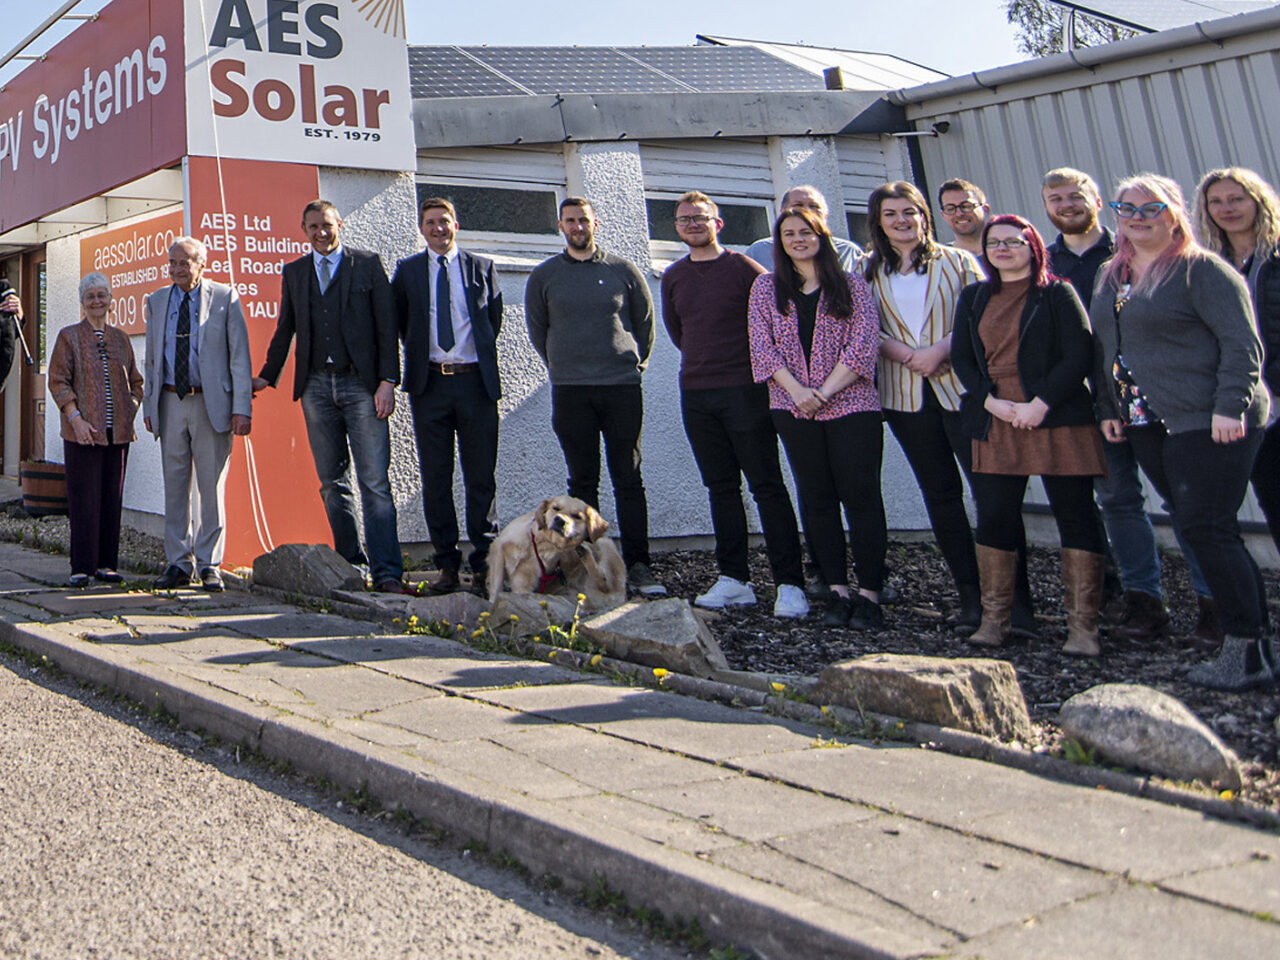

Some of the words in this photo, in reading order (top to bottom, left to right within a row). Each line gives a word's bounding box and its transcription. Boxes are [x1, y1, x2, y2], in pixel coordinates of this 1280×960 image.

[33, 35, 167, 164] Systems
[210, 58, 391, 129] Solar
[304, 127, 339, 140] EST.
[344, 130, 381, 142] 1979
[200, 212, 237, 230] AES
[243, 214, 271, 231] Ltd
[94, 227, 183, 270] aessolar.co
[202, 234, 237, 252] AES
[245, 236, 312, 257] Building
[240, 257, 284, 274] Road
[111, 266, 158, 288] ESTABLISHED
[246, 301, 278, 319] 1AU
